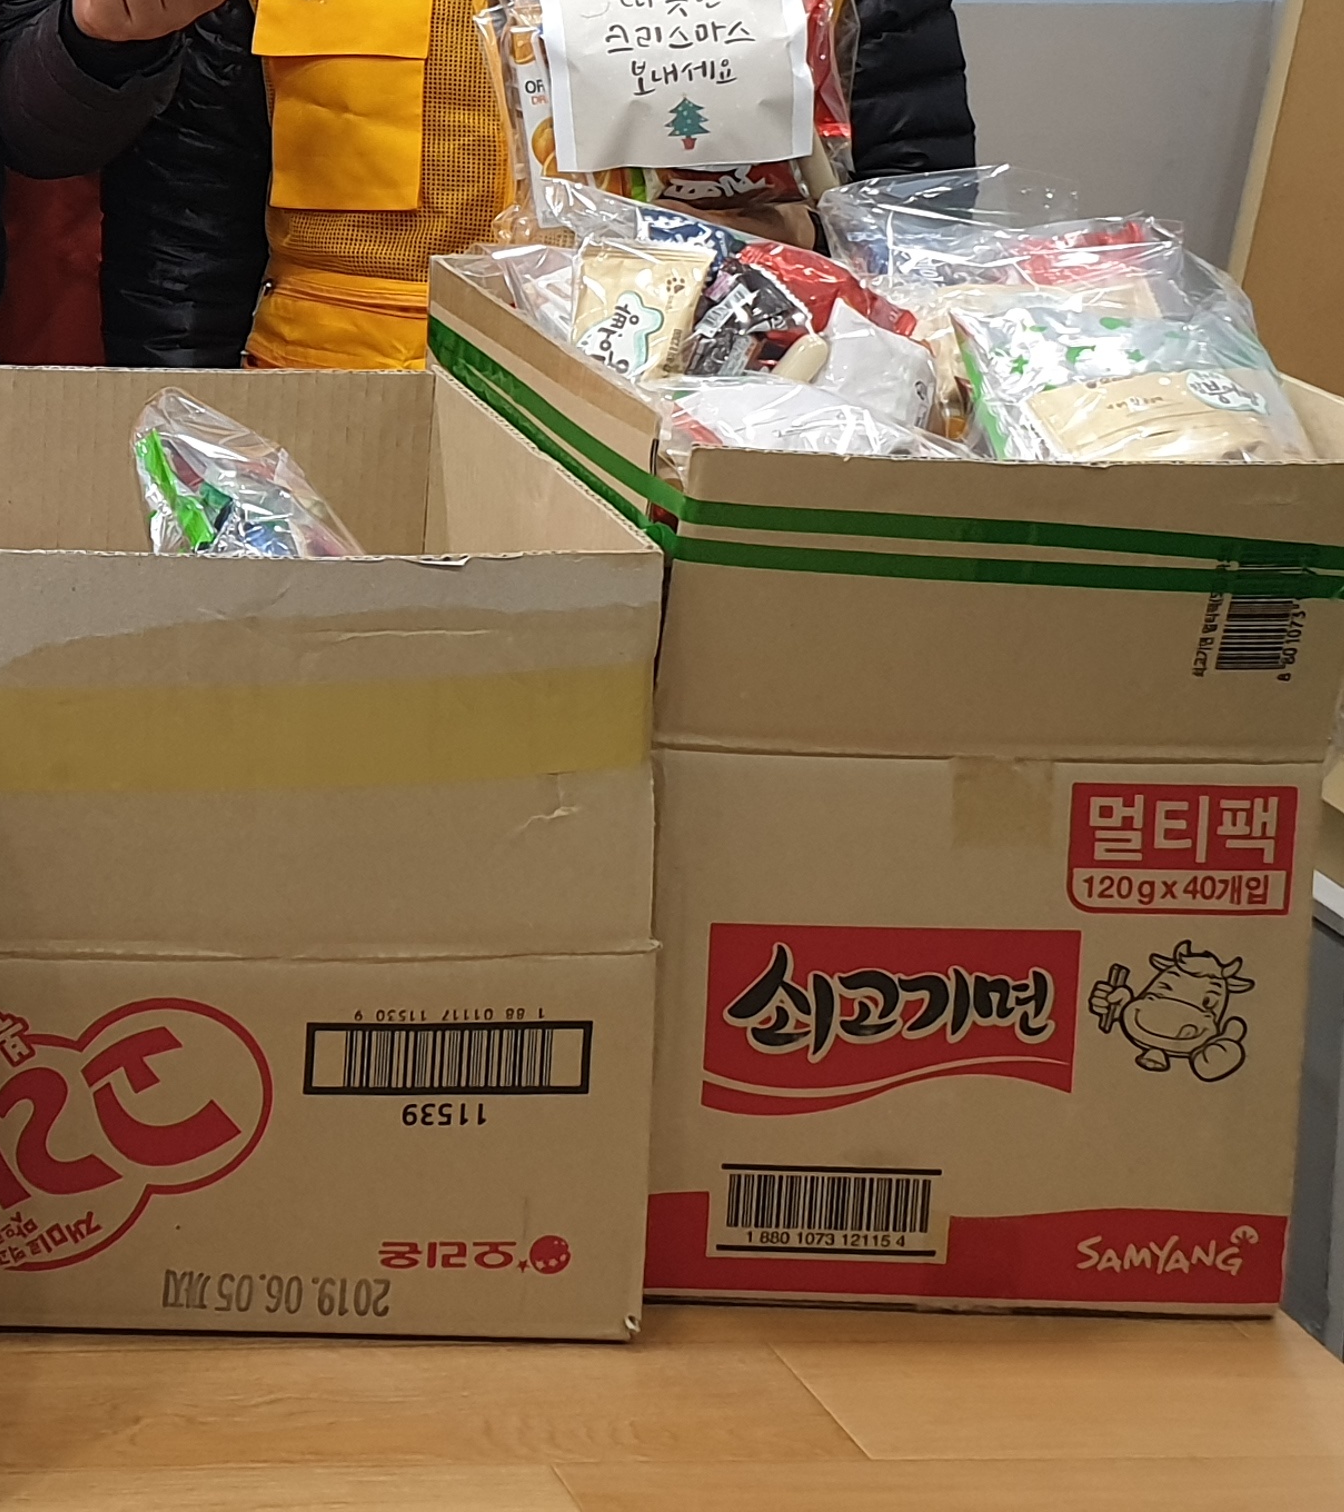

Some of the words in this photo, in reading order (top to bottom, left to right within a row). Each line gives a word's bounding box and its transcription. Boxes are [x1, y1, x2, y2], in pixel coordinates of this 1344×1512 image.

[605, 21, 756, 54] 크리스마스
[631, 59, 737, 95] 보내세요
[1089, 795, 1279, 864] 멀티팩
[724, 941, 1054, 1066] 쇠고기면
[402, 1103, 487, 1126] 11539
[759, 1231, 790, 1246] 880
[796, 1232, 834, 1247] 1073
[841, 1233, 889, 1248] 12115
[1075, 1235, 1245, 1275] SAMYANG
